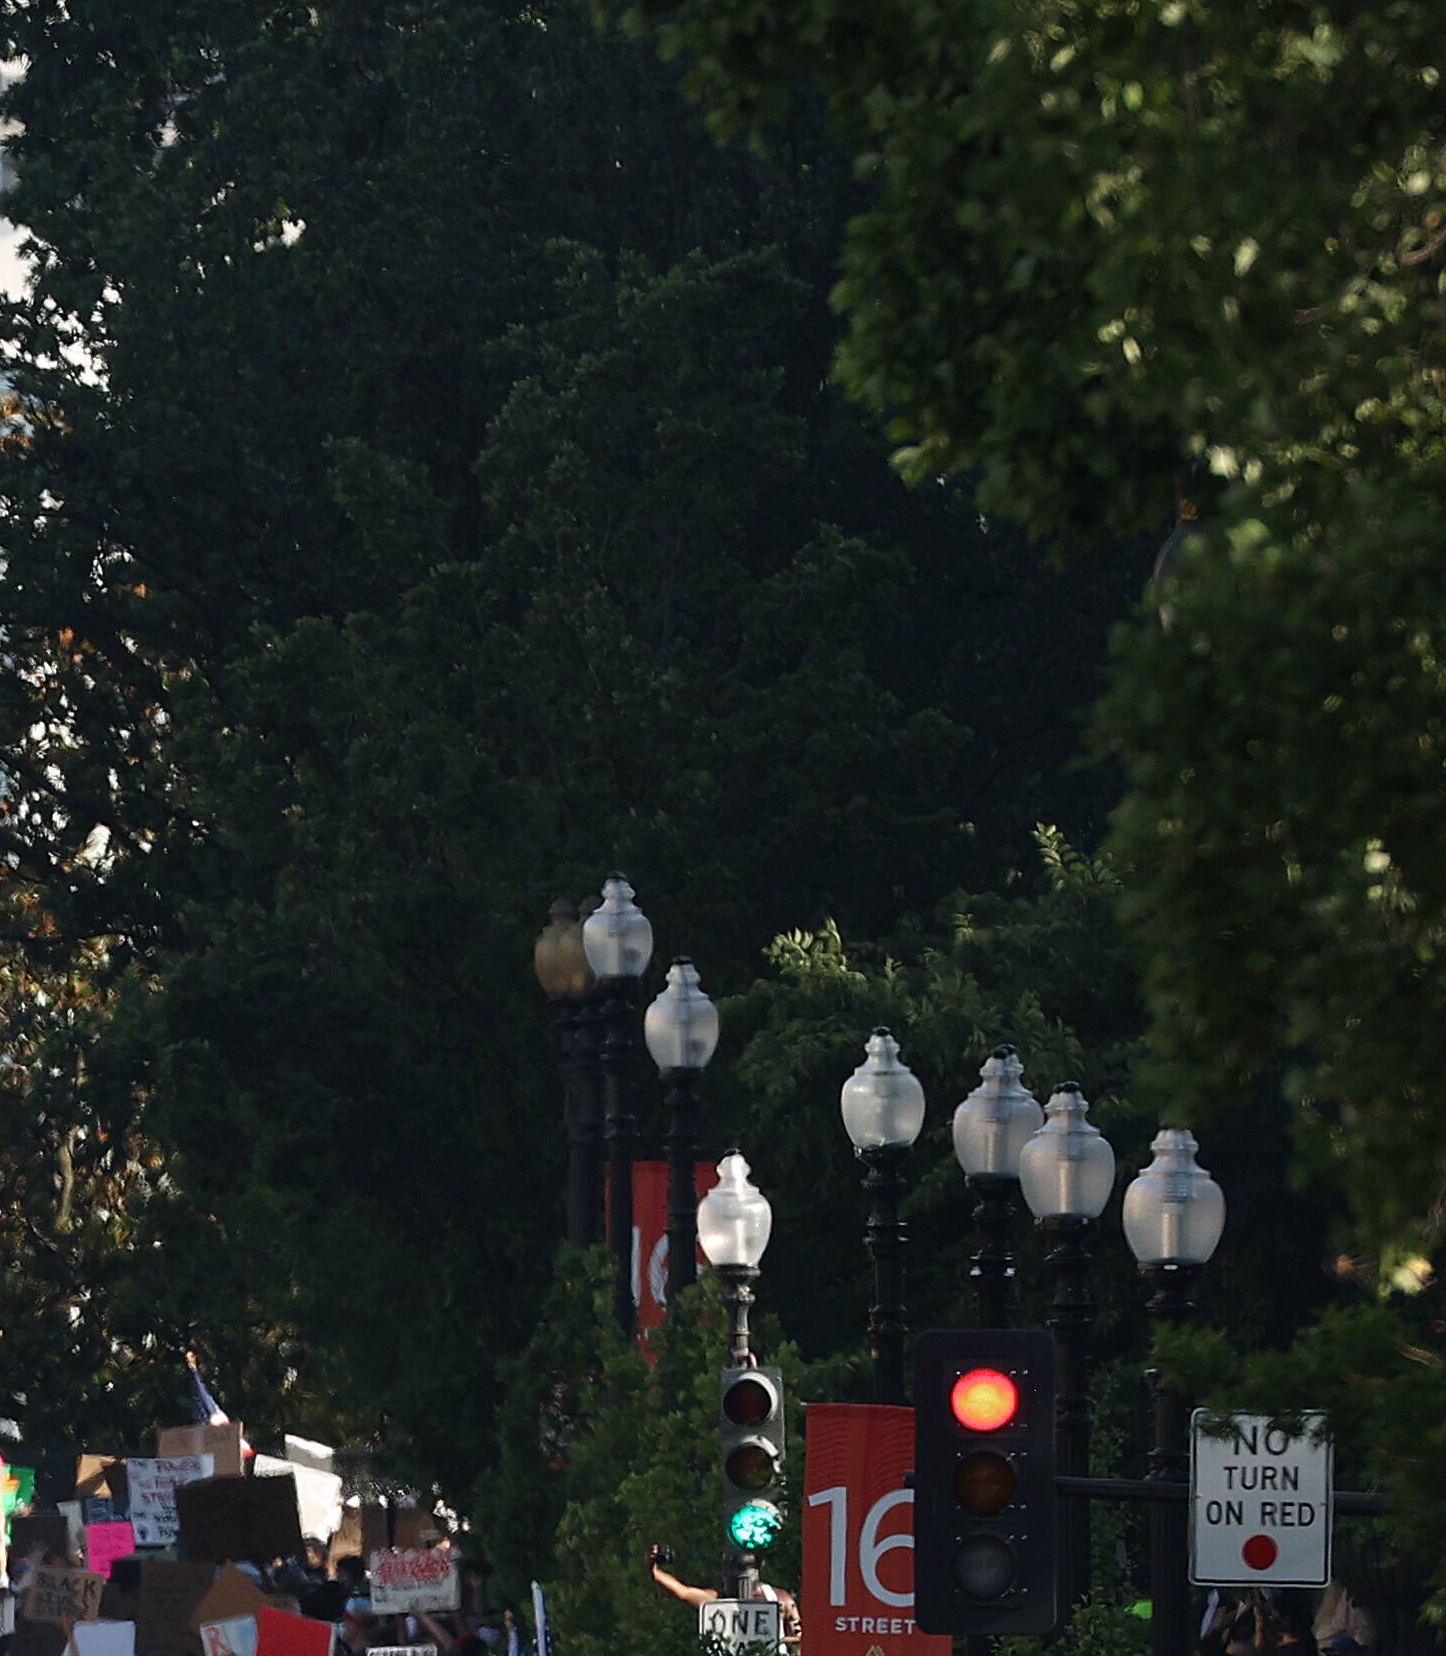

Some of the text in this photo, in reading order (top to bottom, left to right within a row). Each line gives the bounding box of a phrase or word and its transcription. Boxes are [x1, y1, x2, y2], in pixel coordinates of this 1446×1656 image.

[1234, 1424, 1289, 1456] NO
[1224, 1466, 1299, 1490] TURN
[1207, 1501, 1315, 1527] ON RED
[809, 1487, 915, 1608] 16
[712, 1610, 770, 1636] ONE
[835, 1616, 916, 1634] STREET
